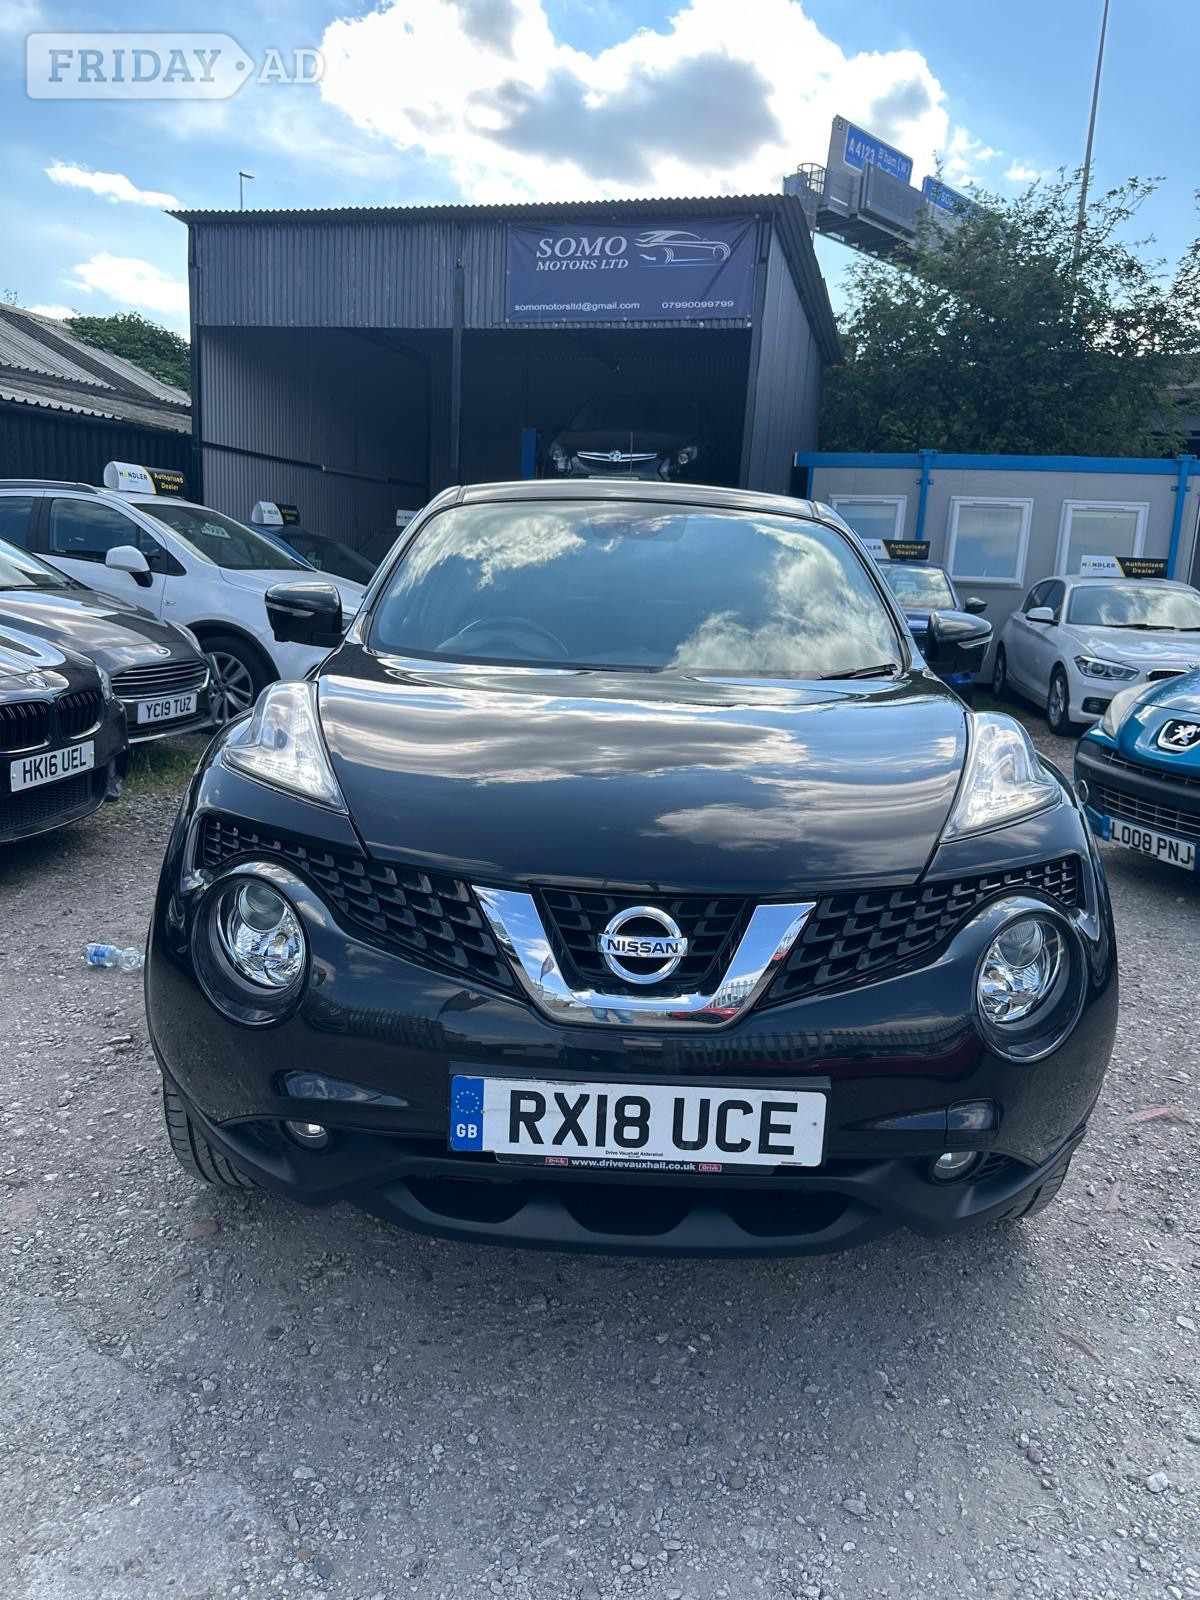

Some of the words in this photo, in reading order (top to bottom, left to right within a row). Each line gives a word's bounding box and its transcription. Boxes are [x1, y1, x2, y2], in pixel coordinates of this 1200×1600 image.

[535, 236, 628, 258] SOMO
[535, 259, 598, 271] MOTORS
[600, 258, 629, 270] LTD
[514, 302, 641, 312] somomotorsltd@gmail.com
[661, 300, 735, 309] 07990099799
[161, 482, 179, 491] Dealer
[146, 702, 171, 719] YC19
[174, 697, 192, 714] TUZ
[22, 754, 58, 784] HK16
[61, 746, 87, 772] UEL
[1156, 836, 1191, 865] PNJ
[607, 938, 679, 954] NISSAN
[508, 1089, 651, 1149] RX18
[672, 1097, 799, 1156] UCE
[456, 1123, 478, 1139] GB
[571, 1158, 697, 1171] www.drivevauxhall.co.uk
